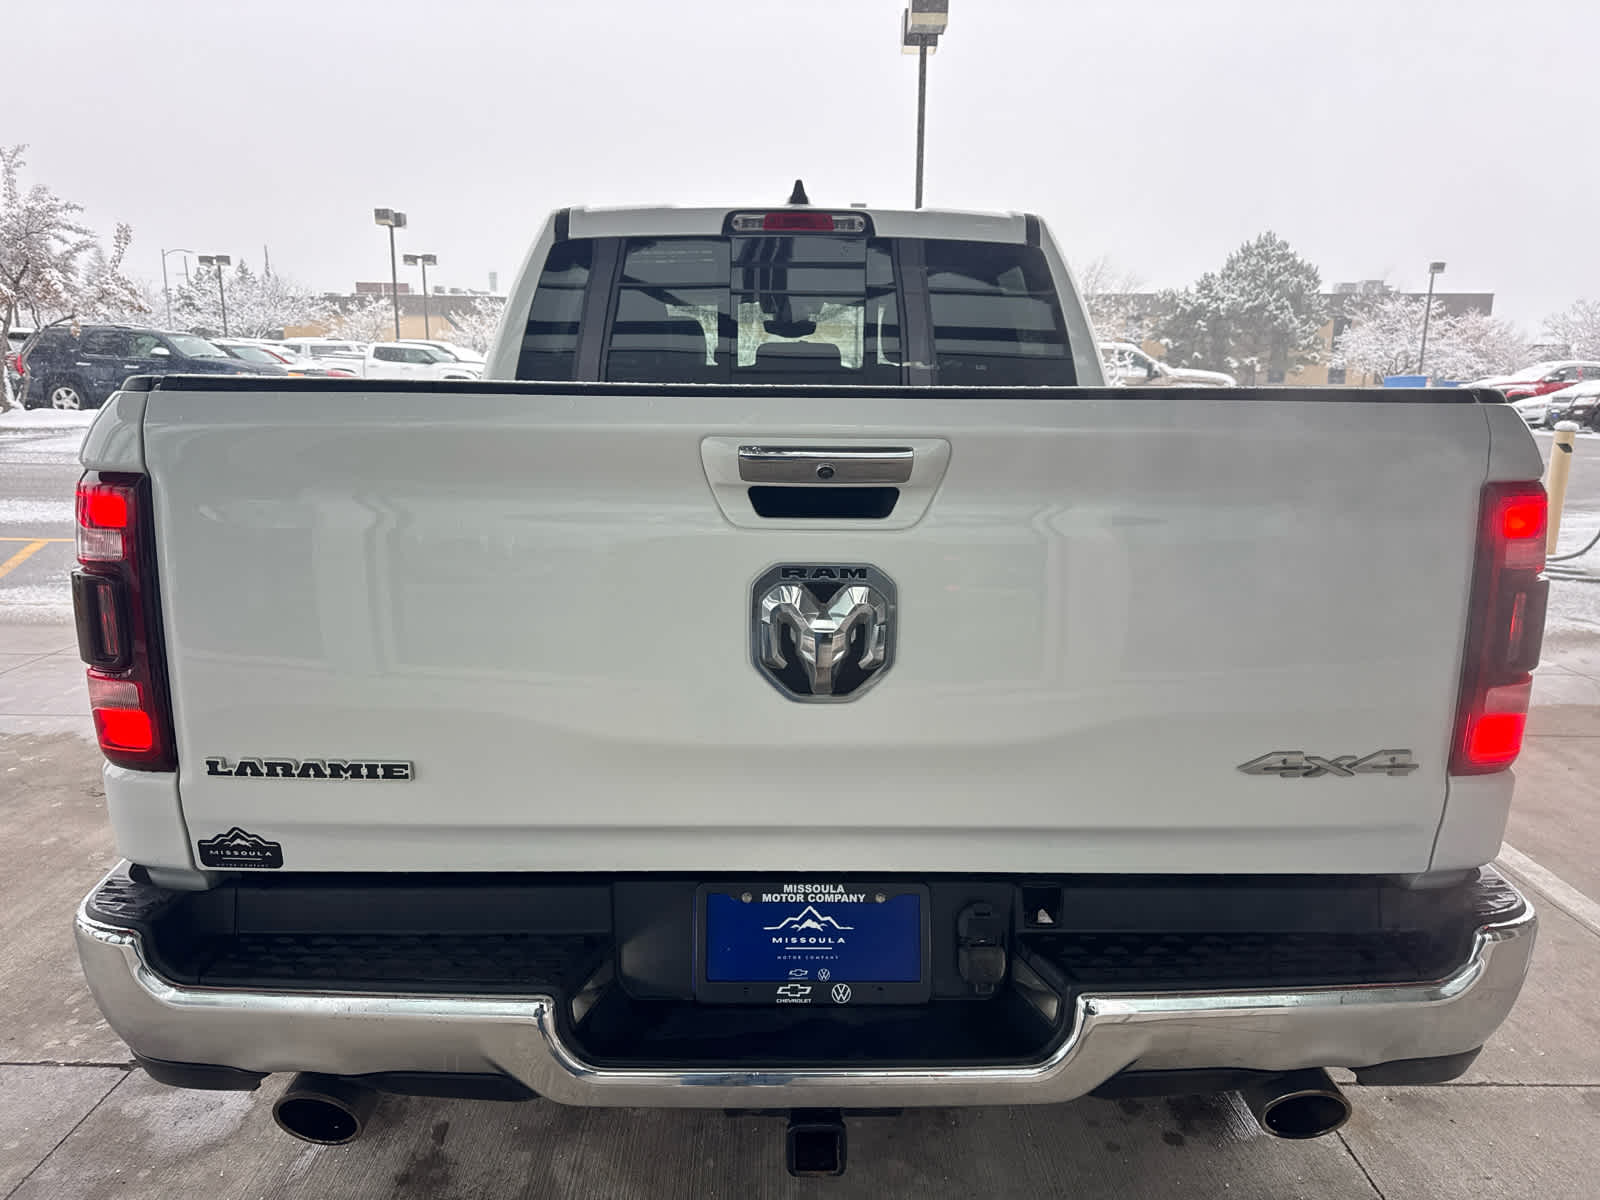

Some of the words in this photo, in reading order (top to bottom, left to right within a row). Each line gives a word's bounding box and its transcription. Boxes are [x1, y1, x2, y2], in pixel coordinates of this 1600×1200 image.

[781, 567, 868, 579] RAM
[205, 758, 412, 780] LARAMIE
[209, 849, 273, 857] MISSOULA
[783, 884, 845, 893] MISSOULA
[762, 894, 804, 903] MOTOR
[807, 894, 866, 903] COMPANY
